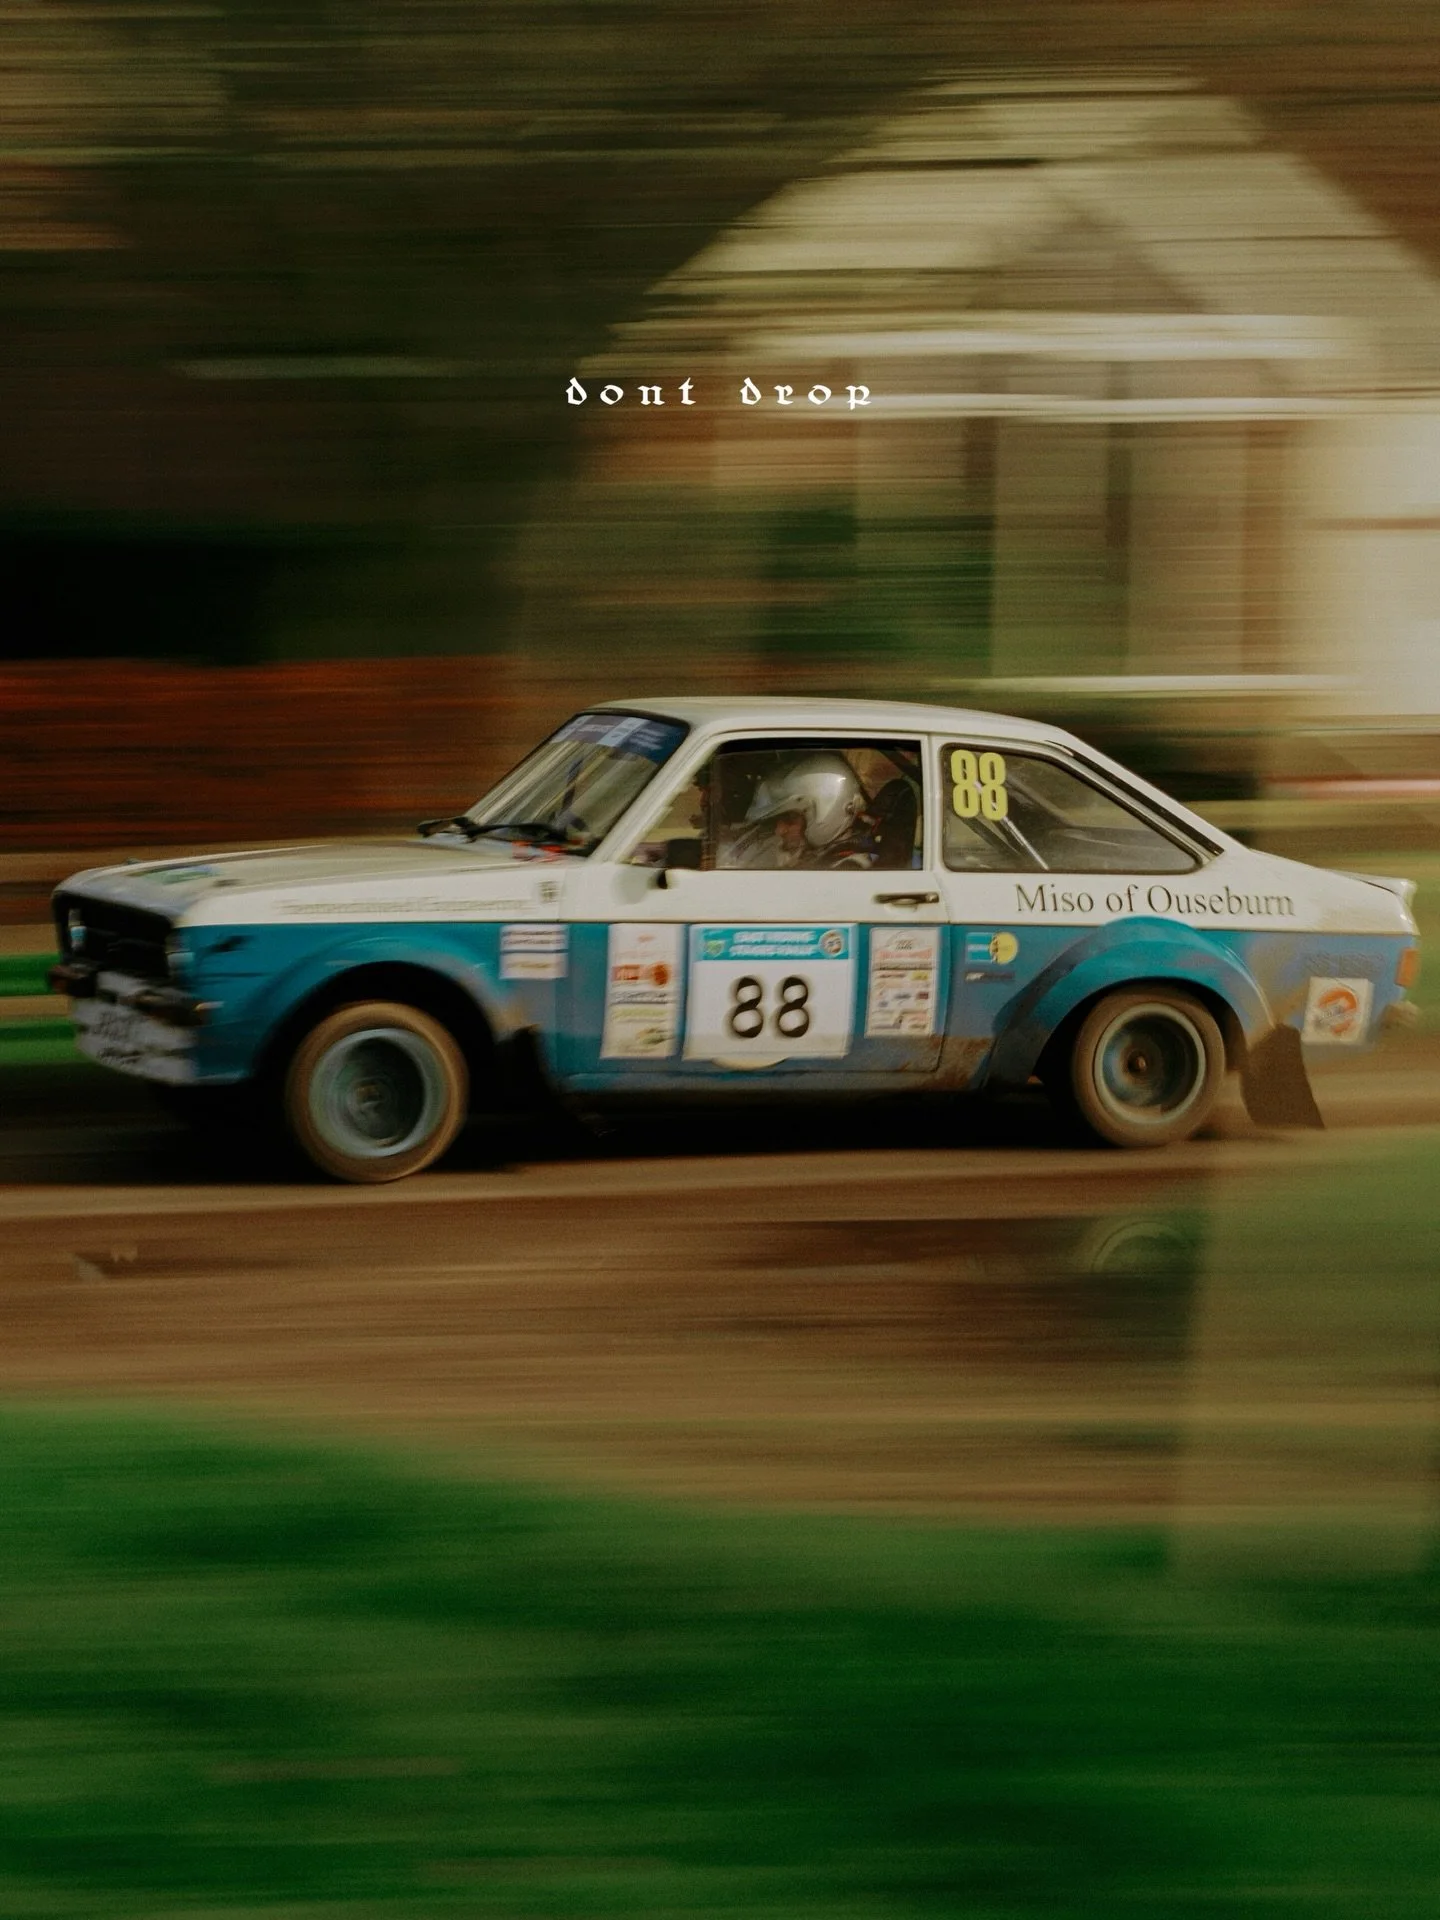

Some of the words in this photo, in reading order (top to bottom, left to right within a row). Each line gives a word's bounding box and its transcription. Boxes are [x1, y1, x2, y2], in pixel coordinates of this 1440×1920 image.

[951, 750, 1008, 820] 88
[1015, 884, 1095, 913] Miso
[1106, 885, 1139, 913] of
[1147, 885, 1295, 916] Ouseburn
[729, 975, 811, 1039] 88
